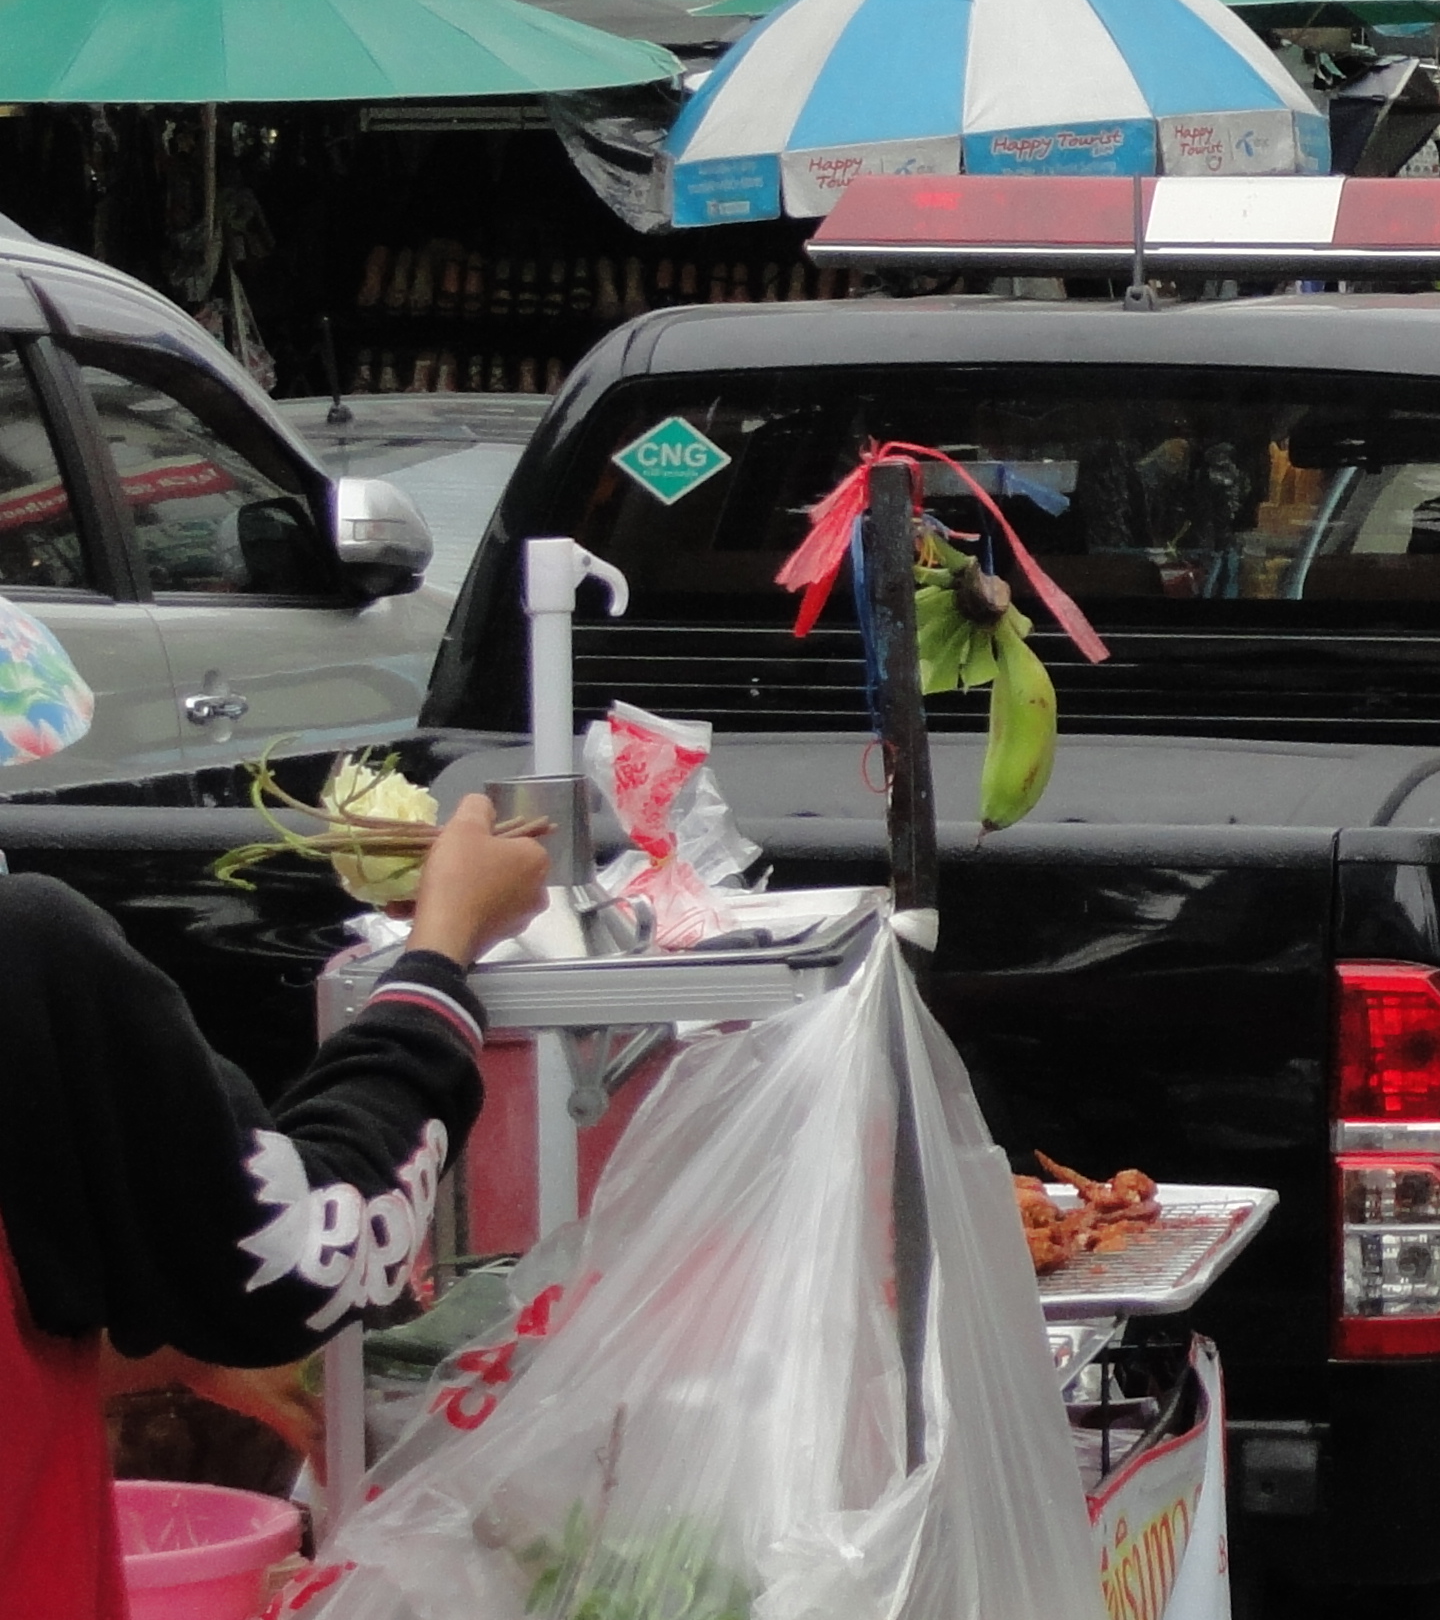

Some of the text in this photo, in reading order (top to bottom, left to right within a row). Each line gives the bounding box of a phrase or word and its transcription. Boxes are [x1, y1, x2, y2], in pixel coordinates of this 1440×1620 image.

[992, 130, 1125, 160] Happy Tourist
[1173, 124, 1214, 147] Happy
[1178, 141, 1223, 158] Tourist
[808, 156, 863, 177] Happy
[637, 442, 708, 468] CNG
